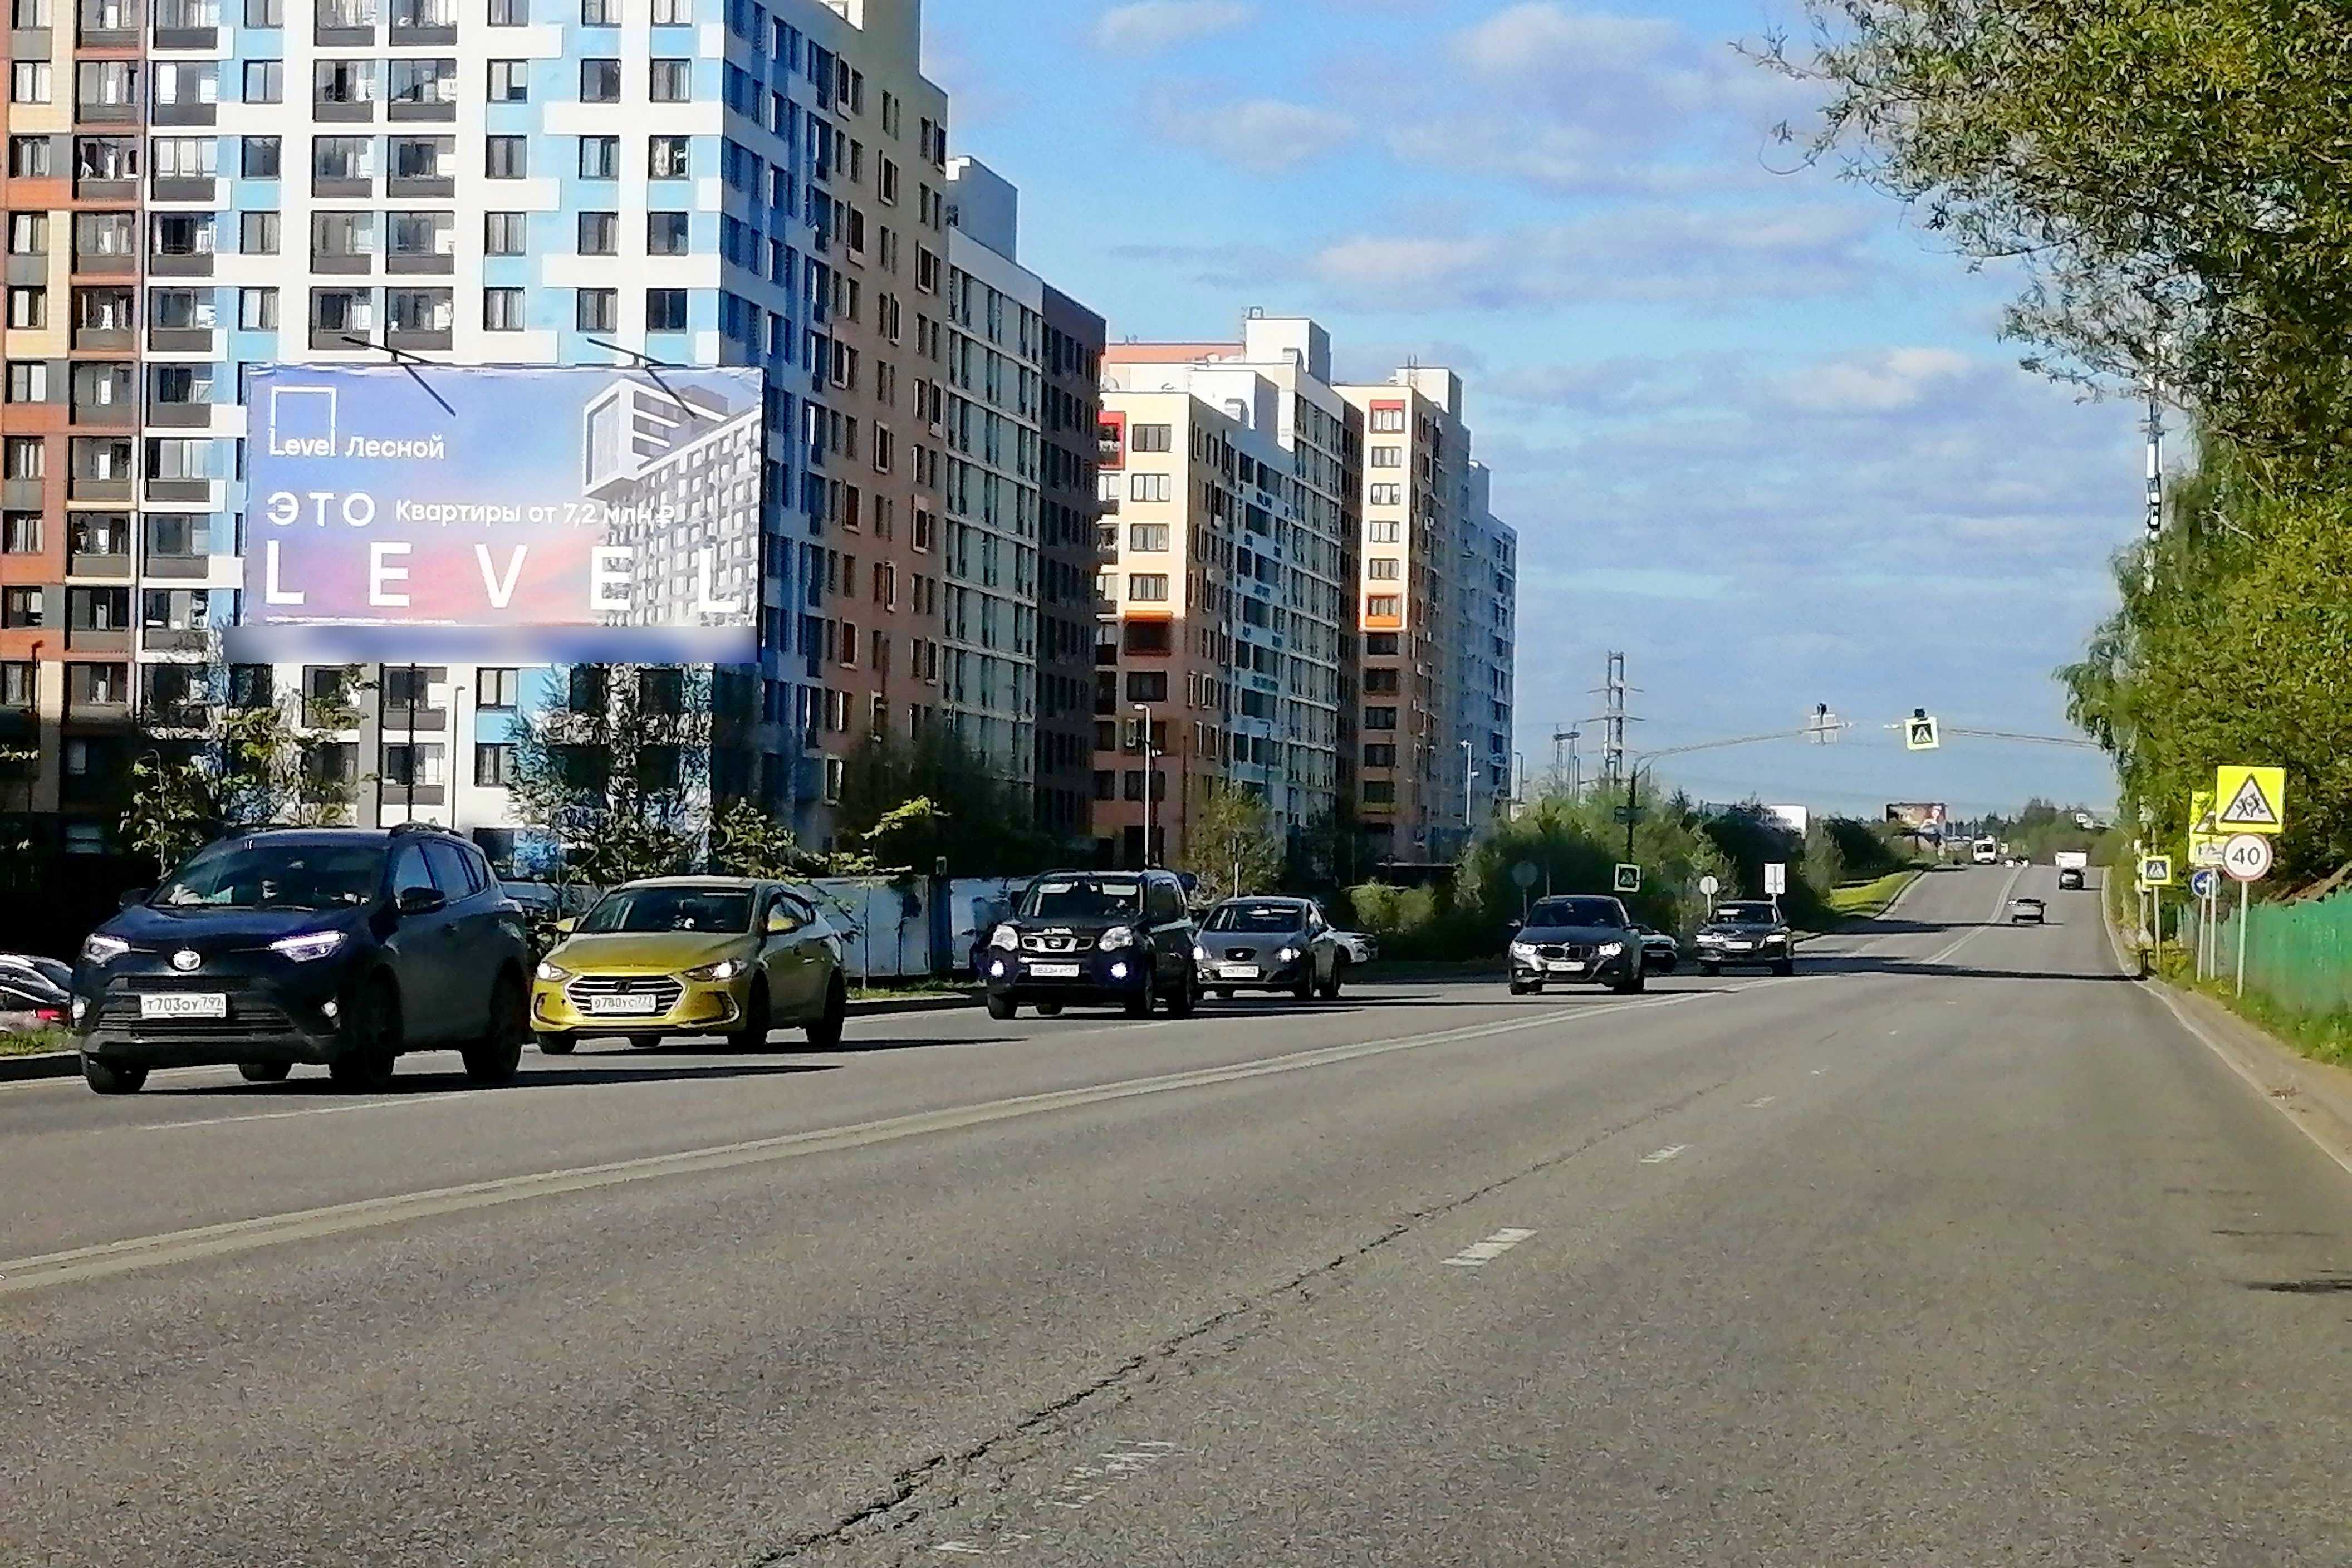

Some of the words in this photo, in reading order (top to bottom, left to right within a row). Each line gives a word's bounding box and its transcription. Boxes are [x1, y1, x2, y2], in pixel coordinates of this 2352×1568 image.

[270, 427, 336, 457] Level
[344, 433, 445, 460] Лесной
[267, 491, 376, 527] ЭТО
[395, 499, 521, 527] Квартиры
[528, 506, 557, 523] от
[564, 502, 599, 530] 7,2
[266, 540, 737, 613] LEVEL
[2232, 847, 2260, 865] 40
